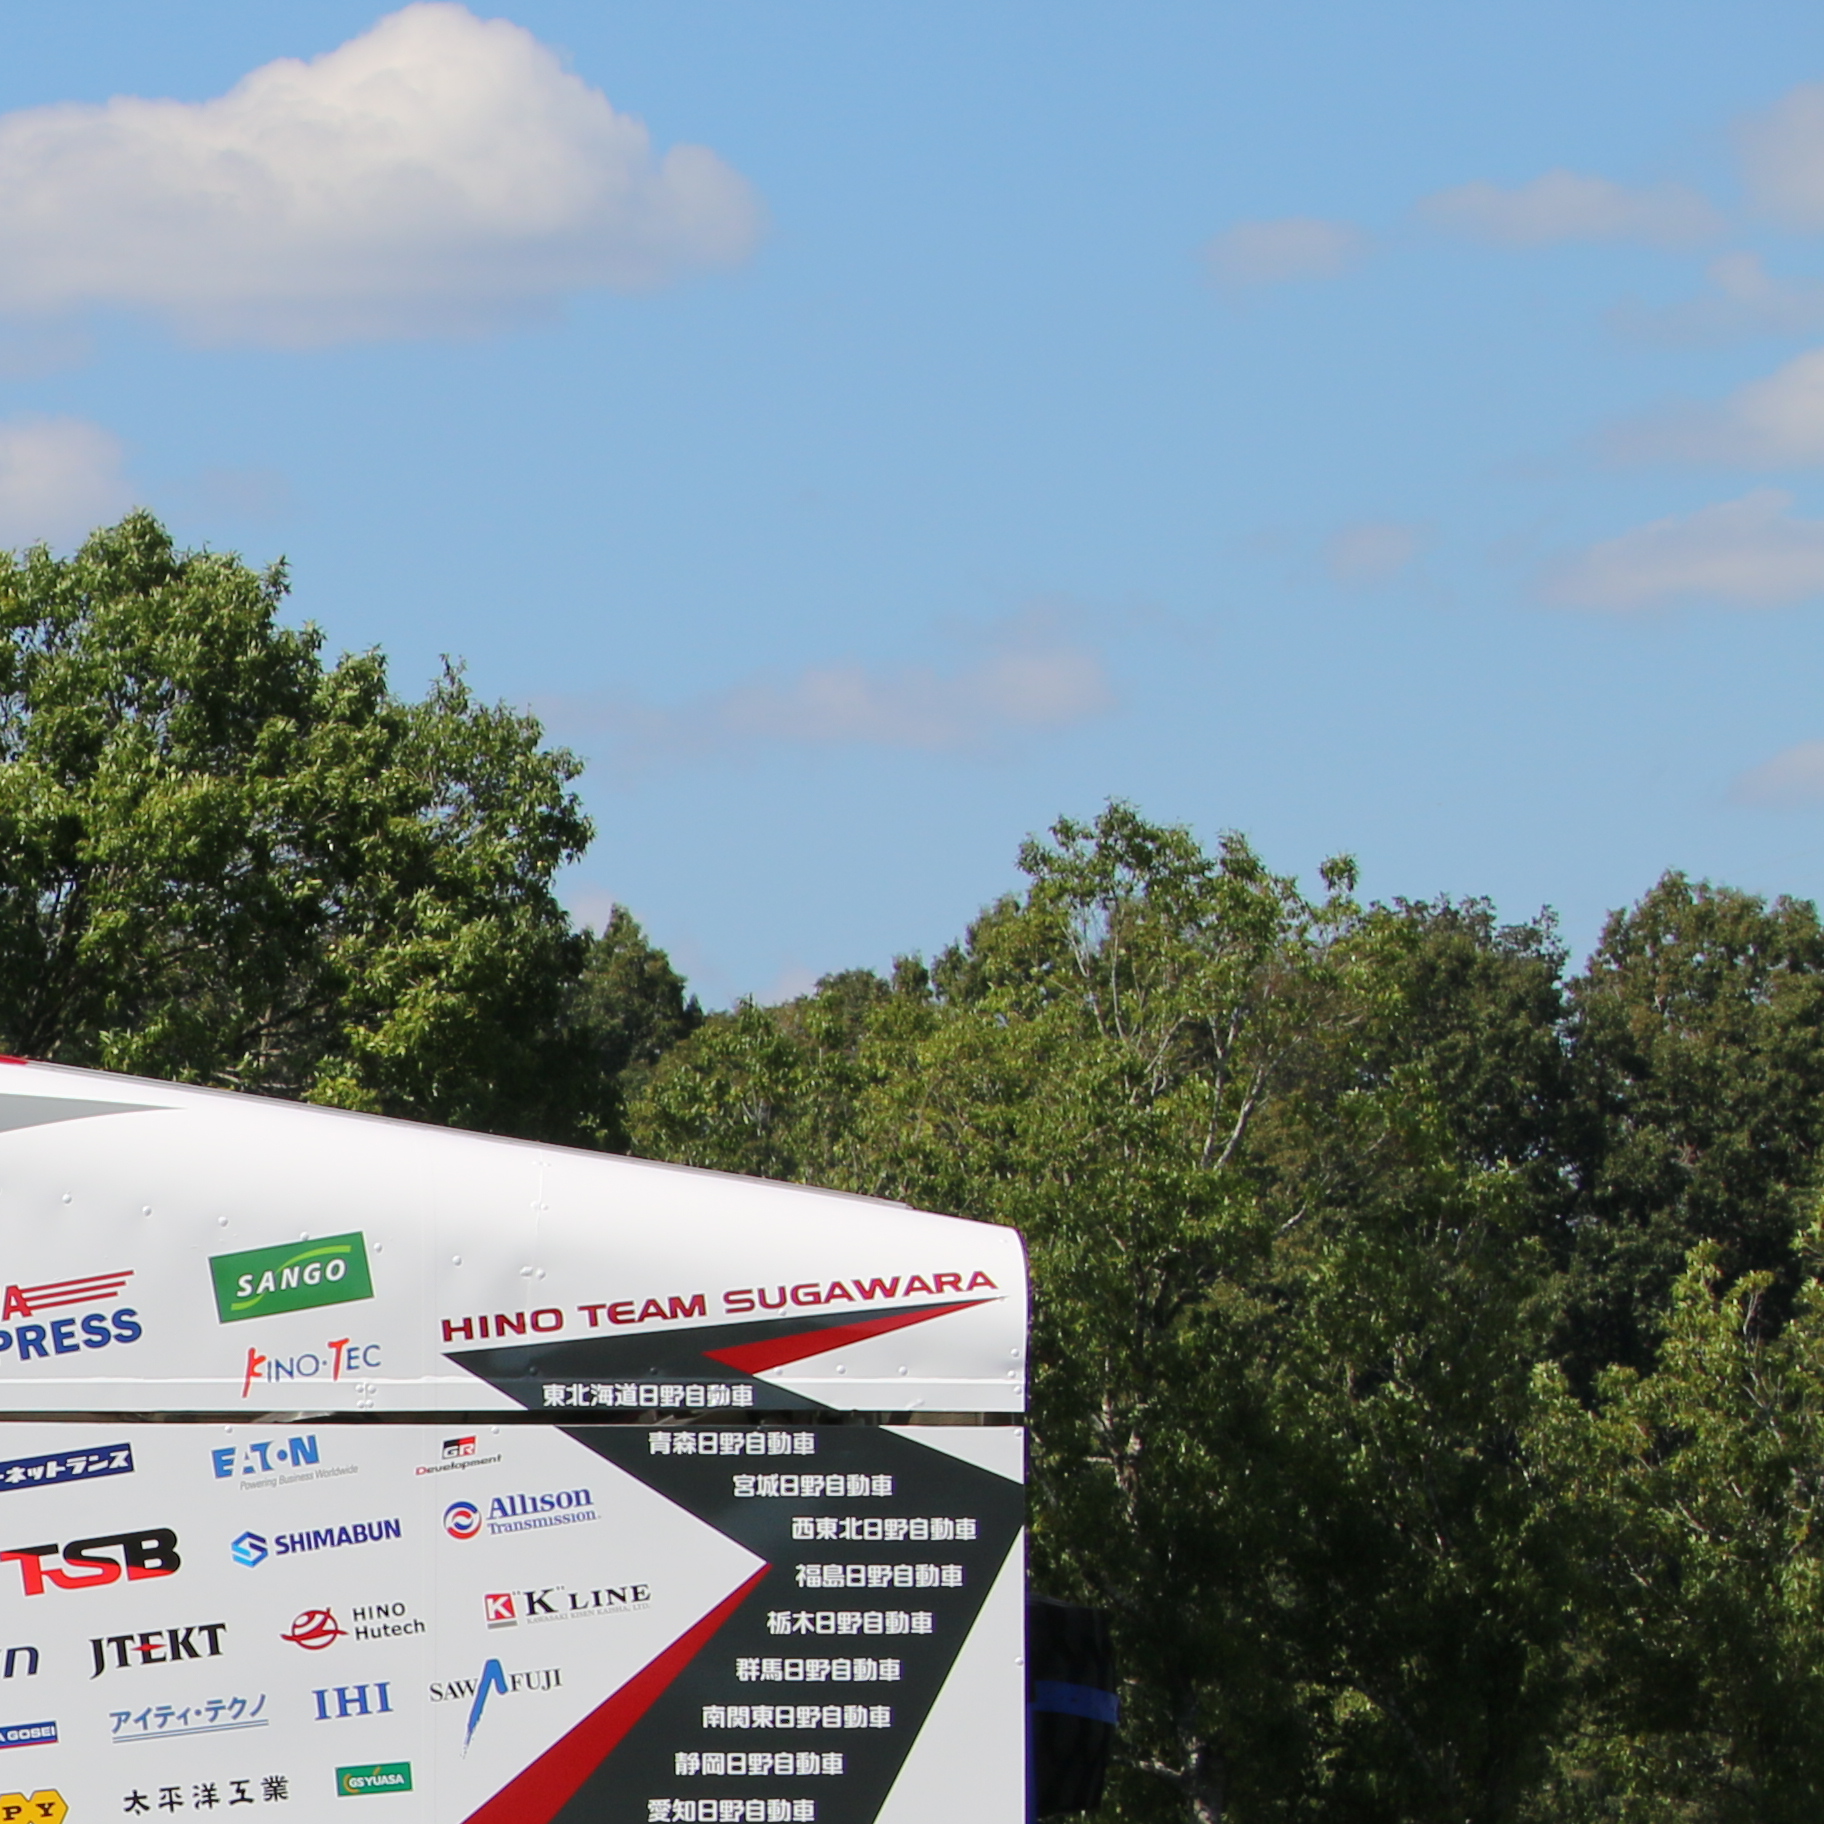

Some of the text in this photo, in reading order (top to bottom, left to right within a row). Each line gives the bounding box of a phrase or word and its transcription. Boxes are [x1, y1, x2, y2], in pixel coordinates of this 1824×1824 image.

[236, 1258, 346, 1298] SANGO
[443, 1269, 997, 1343] HINO TEAM SUGAWARA
[543, 1384, 753, 1408] 東北海道日野自動車
[444, 1442, 474, 1458] GR
[649, 1432, 815, 1456] 青森日野自動車
[240, 1464, 358, 1490] Powering Business Worldwide
[416, 1454, 502, 1476] Development
[734, 1474, 893, 1497] 宮城日野自動車
[486, 1488, 593, 1520] Allison
[275, 1519, 402, 1555] SHIMABUN
[792, 1517, 977, 1541] 西東北日野自動車
[0, 1527, 181, 1596] TSB
[795, 1563, 963, 1588] 福島日野自動車
[569, 1584, 651, 1609] LINE
[353, 1602, 406, 1622] HINO
[767, 1611, 933, 1636] 栃木日野自動車
[355, 1619, 426, 1642] Hutech
[89, 1624, 226, 1679] JTEKT
[736, 1658, 900, 1682] 群馬日野自動車
[312, 1681, 393, 1721] IHI
[702, 1706, 891, 1728] 南関東日野自動車
[8, 1726, 56, 1740] GOSEI
[675, 1752, 843, 1776] 静岡日野自動車
[369, 1774, 405, 1786] YUASA
[124, 1775, 289, 1815] 太平洋工業
[648, 1799, 814, 1822] 愛知日野自動車
